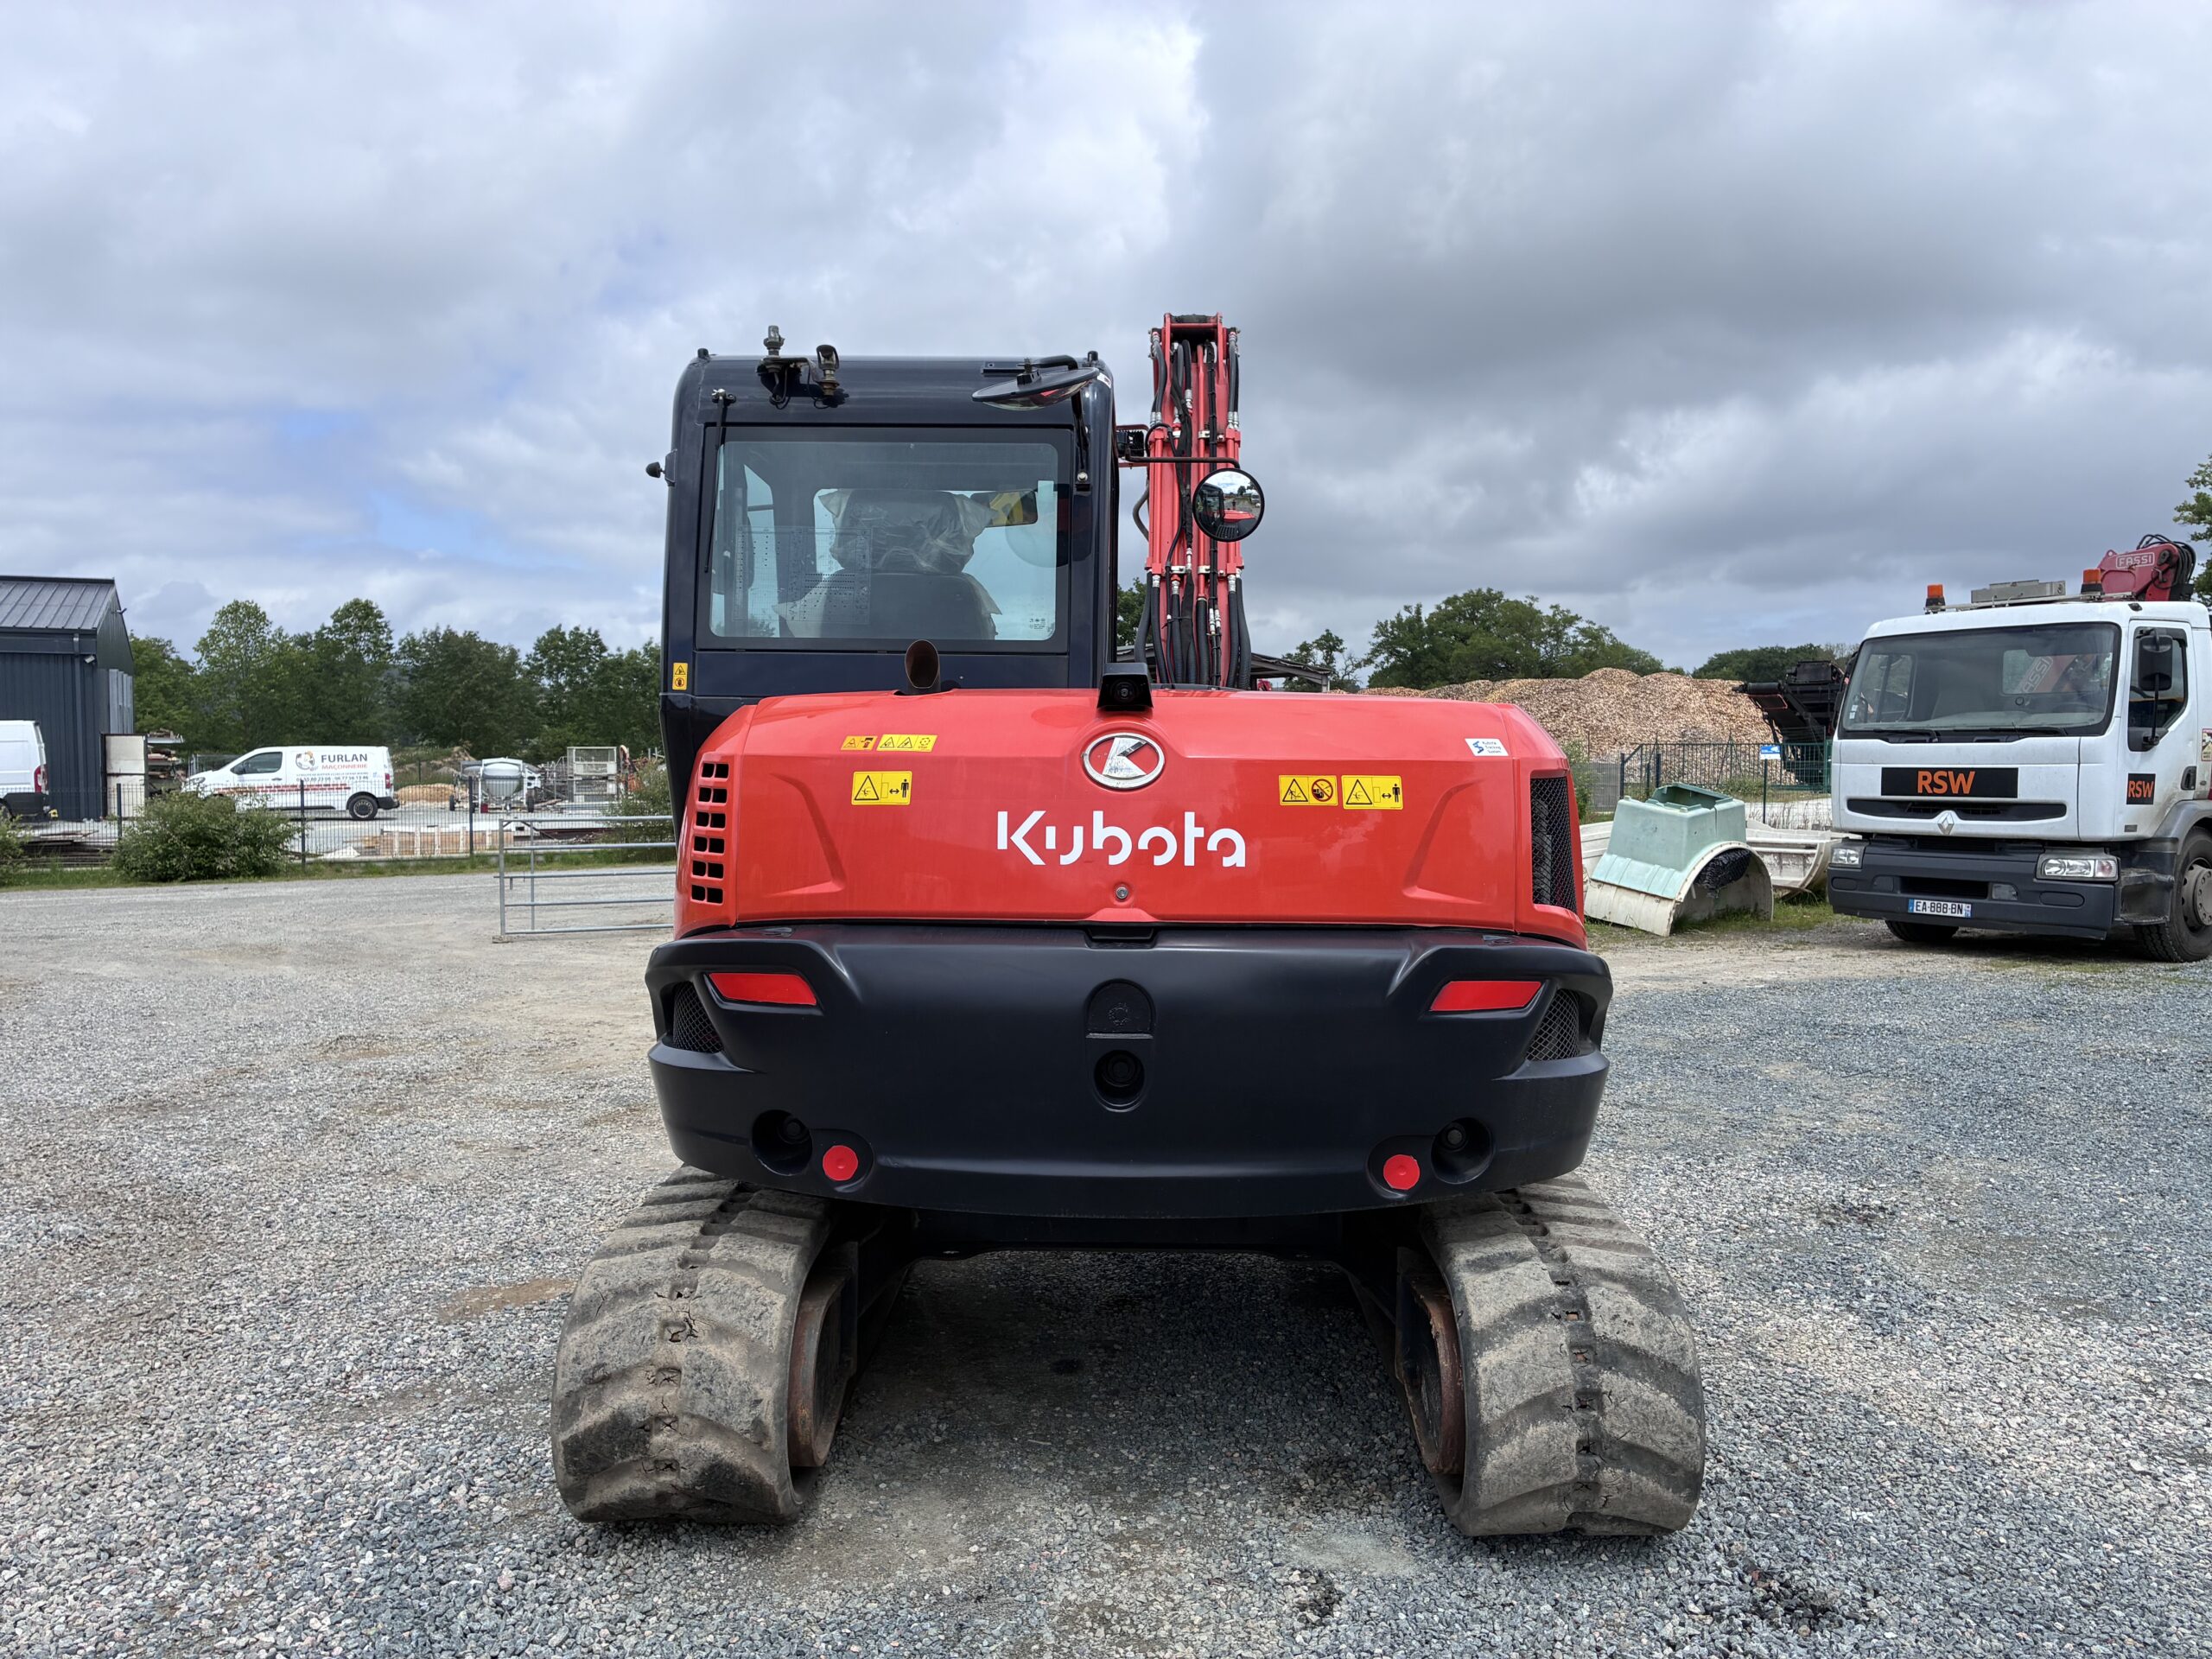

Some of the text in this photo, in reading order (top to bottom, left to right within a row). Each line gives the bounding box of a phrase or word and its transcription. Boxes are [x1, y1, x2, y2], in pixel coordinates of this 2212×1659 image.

[2119, 555, 2152, 567] FASSI
[321, 753, 368, 763] FURLAN
[1917, 771, 1976, 794] RSW
[2128, 780, 2154, 798] RSW
[997, 810, 1246, 867] Kubota
[1916, 900, 1963, 914] EA-888-BN
